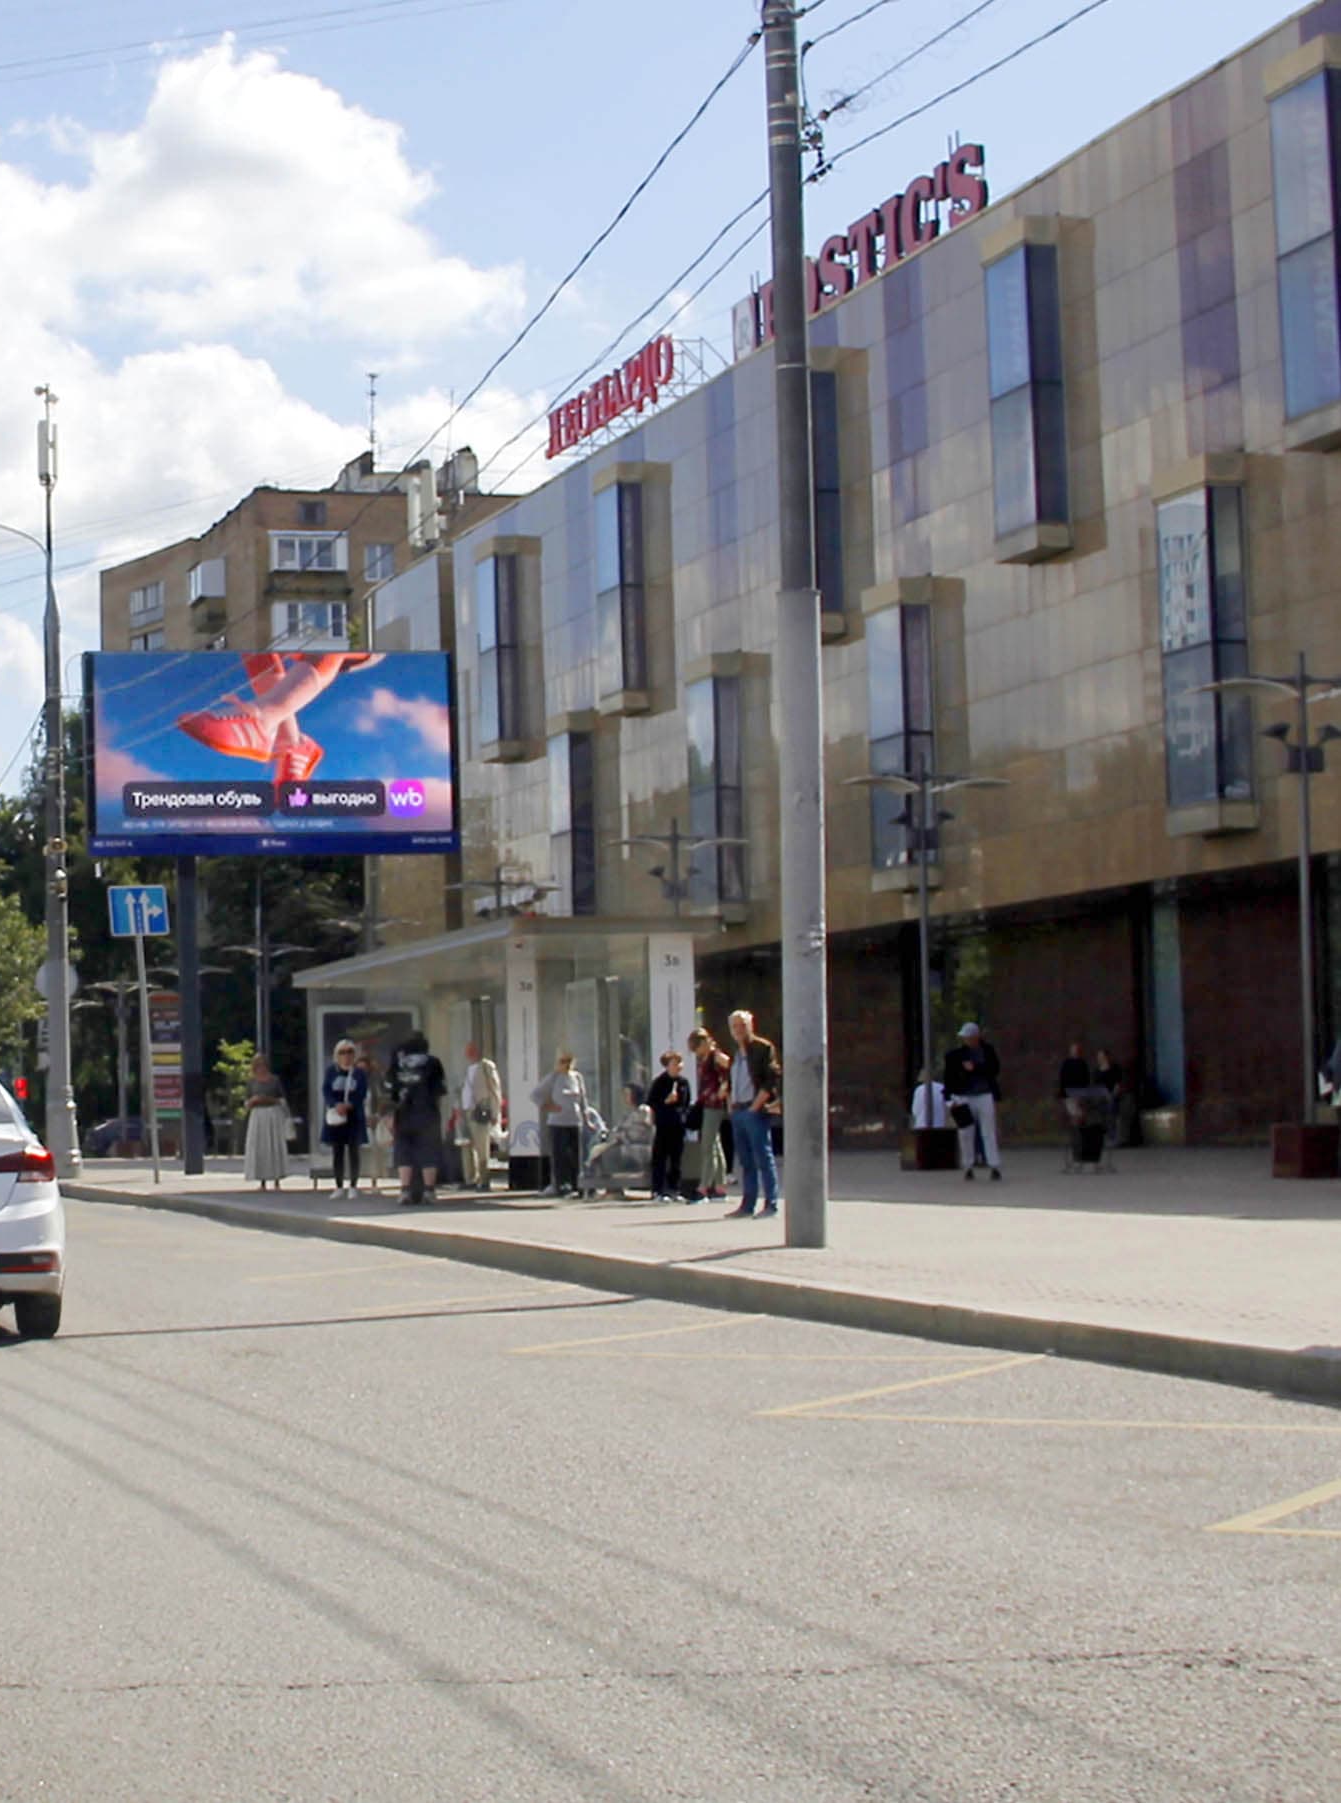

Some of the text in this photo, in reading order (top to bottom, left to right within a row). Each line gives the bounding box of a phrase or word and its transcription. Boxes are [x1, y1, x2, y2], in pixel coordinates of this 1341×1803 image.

[132, 791, 262, 808] Трендовая обувь
[312, 793, 377, 807] выгодно
[390, 787, 423, 807] wb
